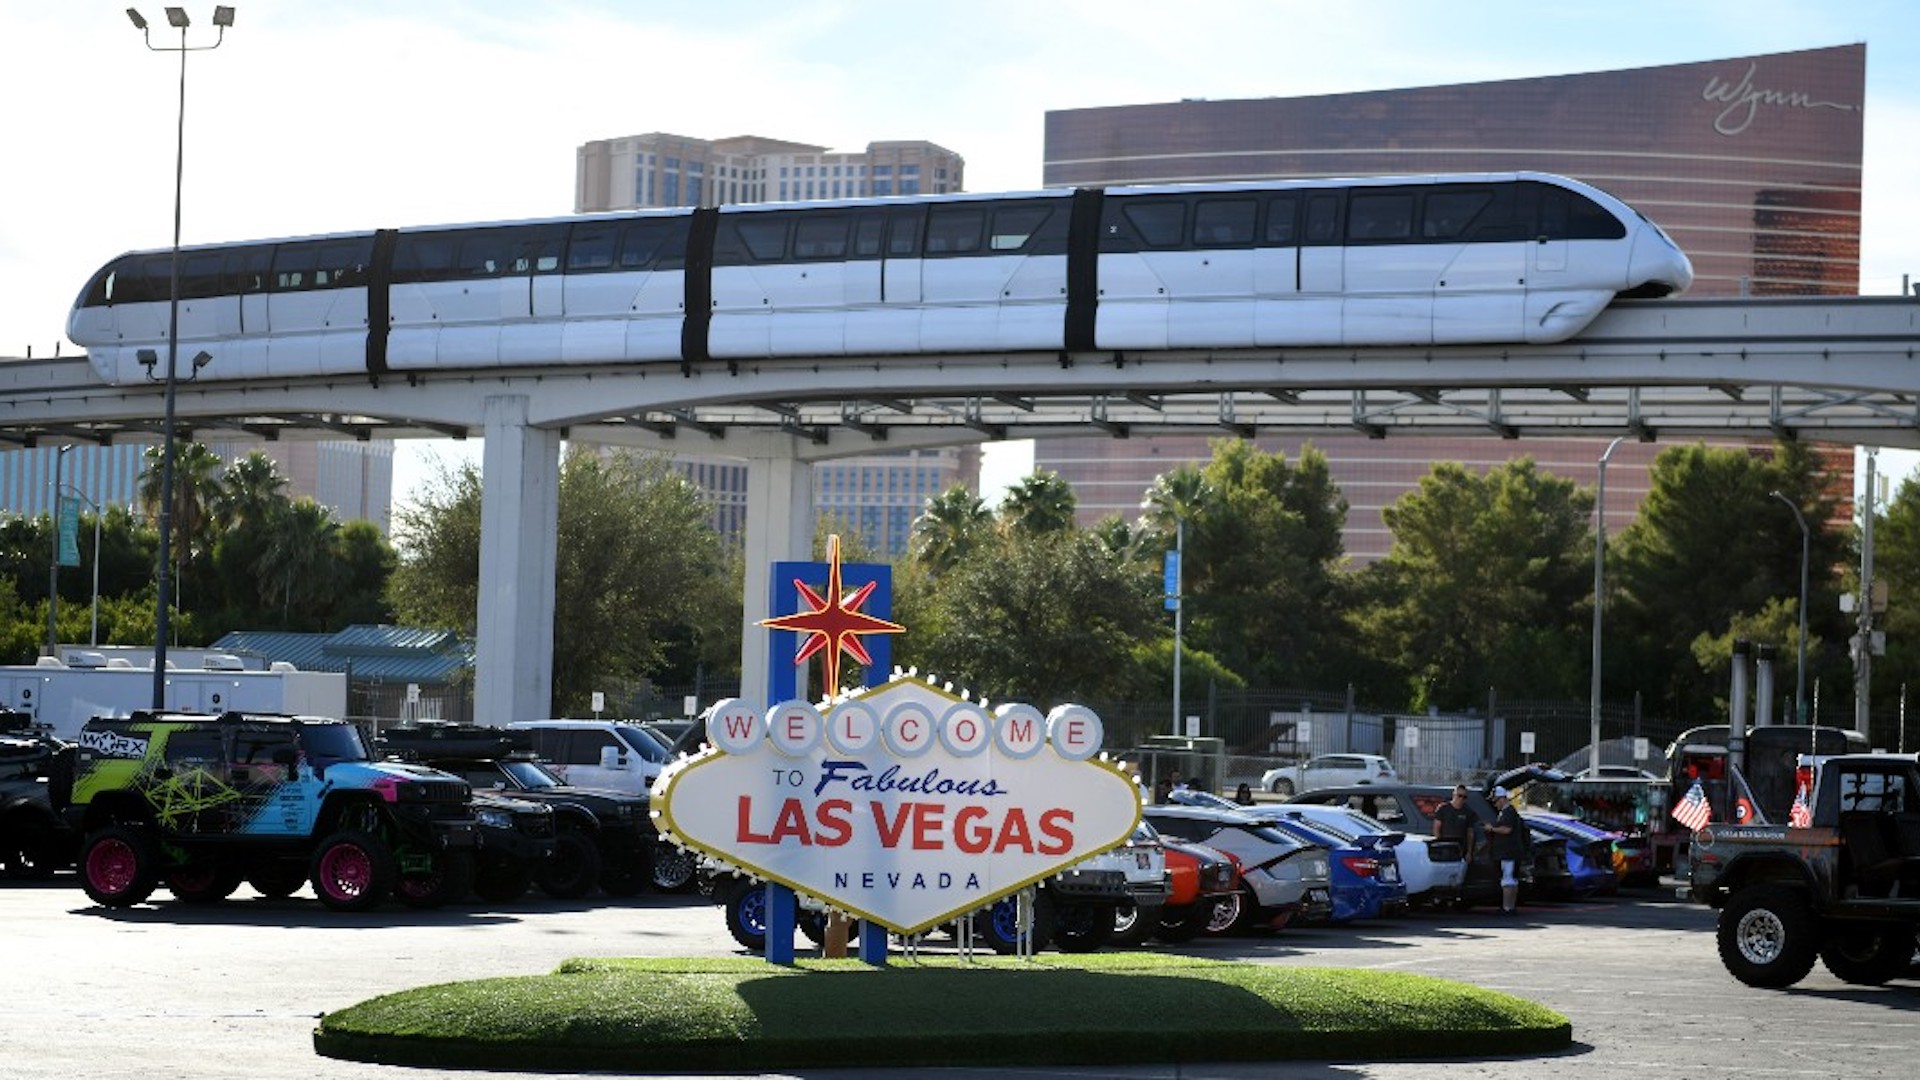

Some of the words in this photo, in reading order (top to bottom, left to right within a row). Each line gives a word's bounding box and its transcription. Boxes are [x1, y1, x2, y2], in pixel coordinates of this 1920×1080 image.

[724, 715, 1085, 744] WELCOME
[772, 769, 804, 787] TO
[814, 759, 1008, 797] Fabulous
[736, 795, 853, 848] LAS
[869, 800, 1075, 856] VEGAS
[835, 872, 981, 890] NEVADA
